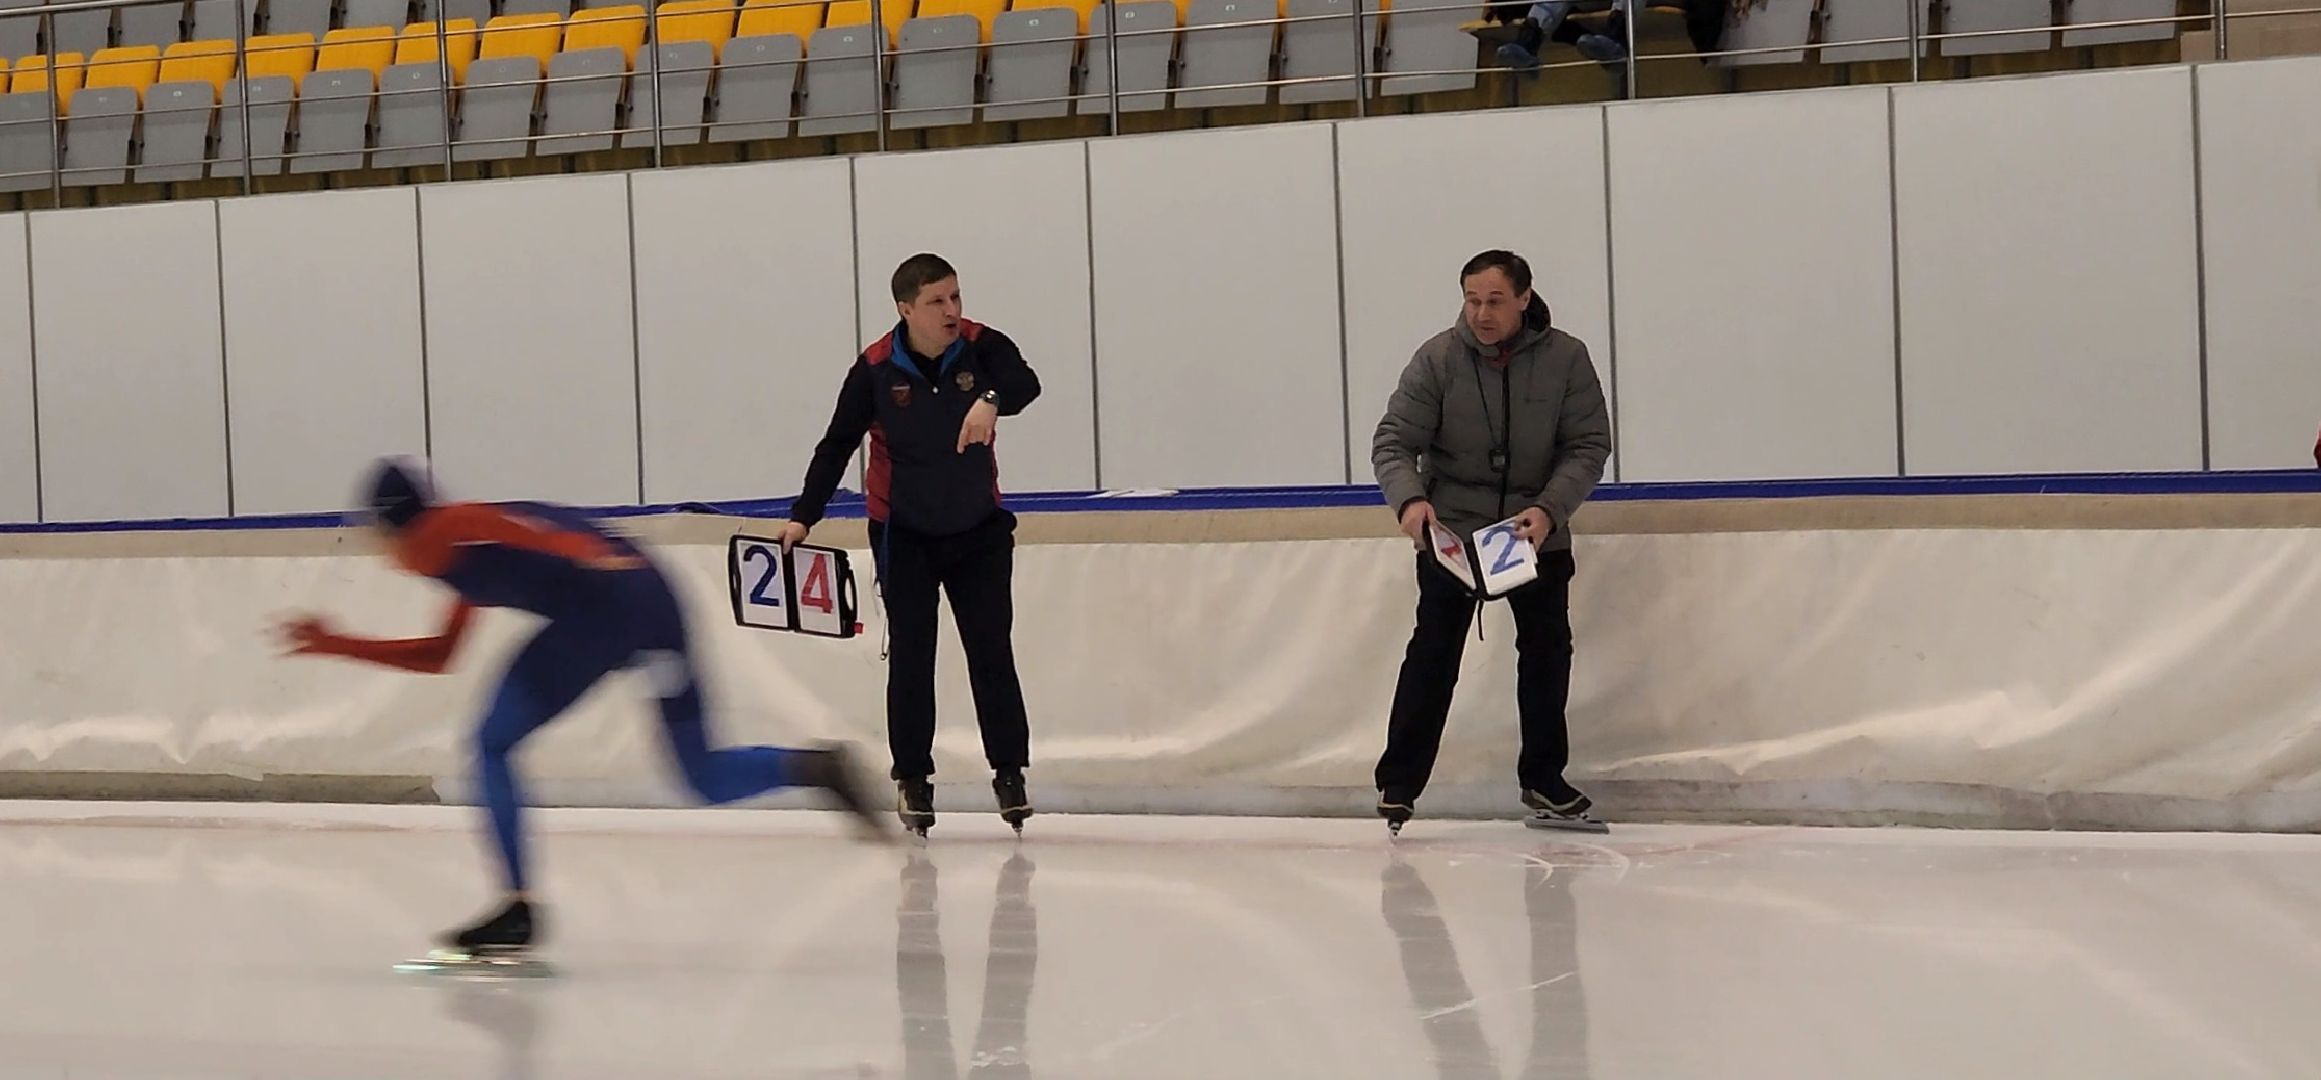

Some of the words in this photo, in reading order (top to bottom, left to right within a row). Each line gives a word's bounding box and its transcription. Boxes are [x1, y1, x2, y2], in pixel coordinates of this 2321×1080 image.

[743, 544, 780, 607] 2
[801, 553, 833, 614] 4
[1481, 525, 1525, 576] 2
